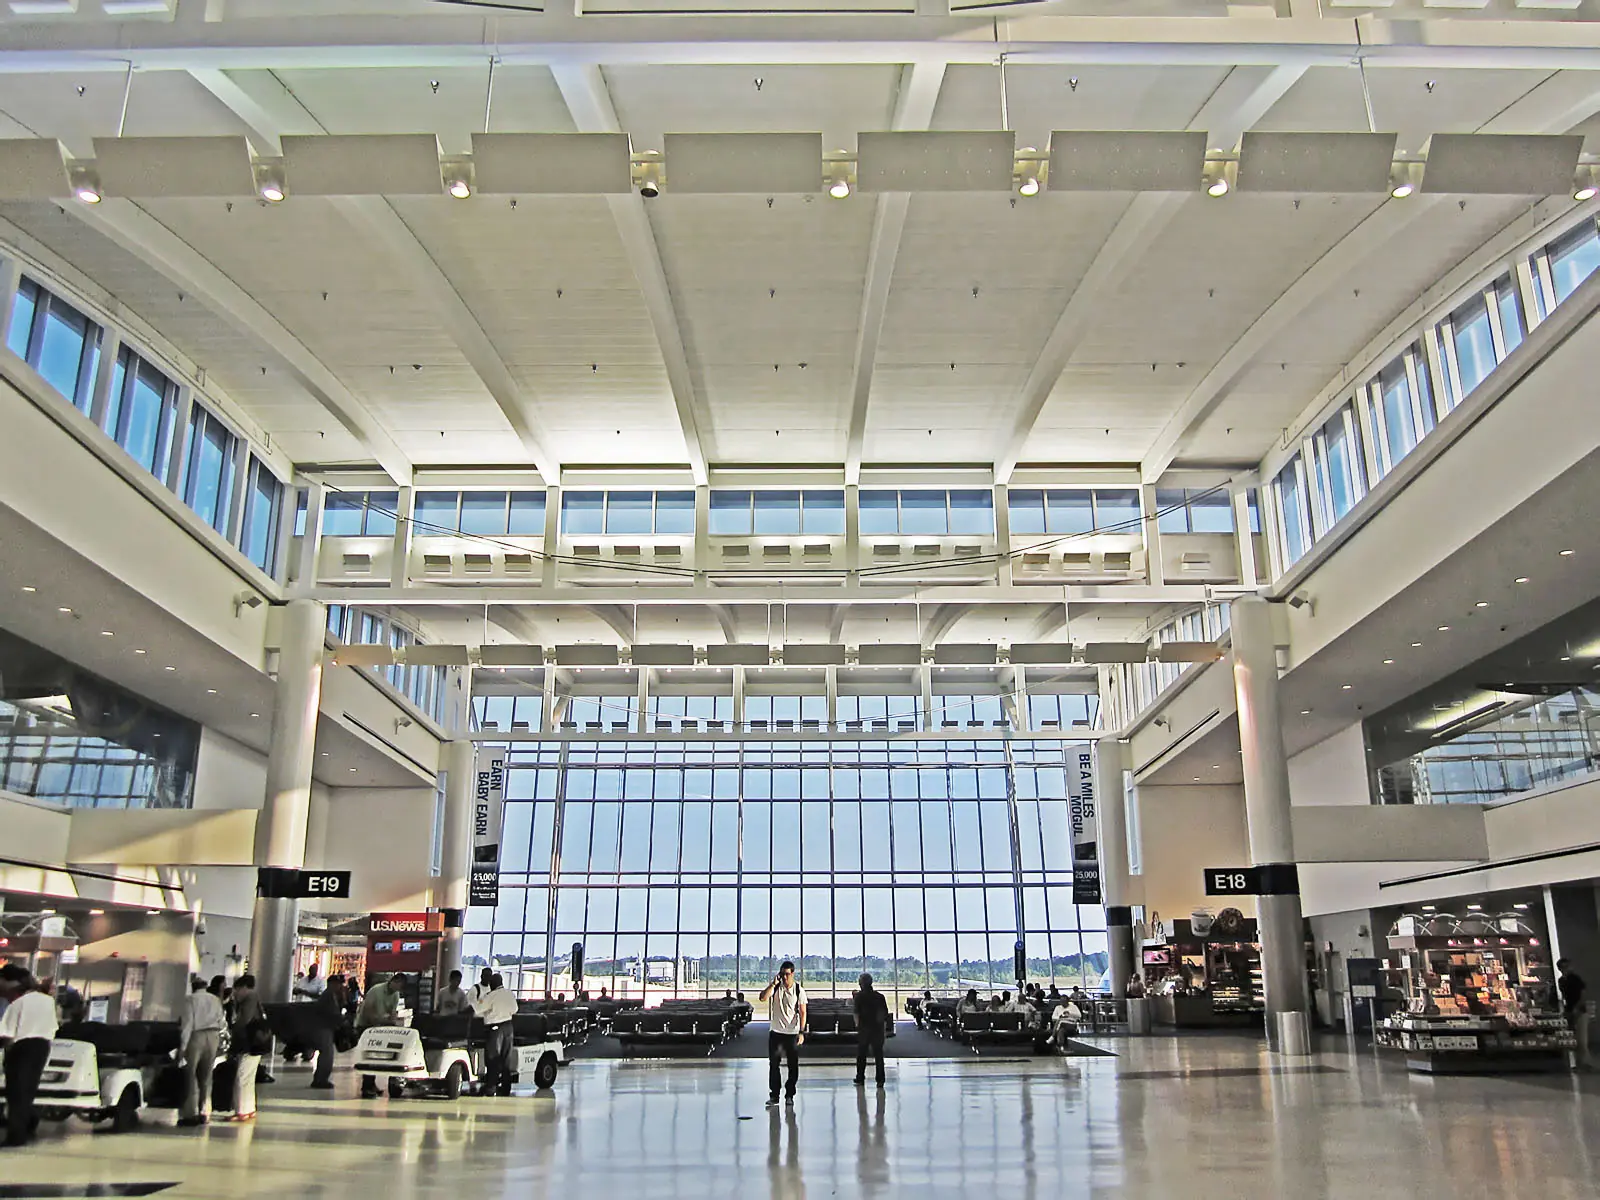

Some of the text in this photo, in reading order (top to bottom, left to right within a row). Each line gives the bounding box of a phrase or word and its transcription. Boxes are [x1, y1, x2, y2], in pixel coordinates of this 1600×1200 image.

[490, 759, 503, 791] EARN
[1079, 753, 1094, 818] BE A MILES
[475, 771, 490, 836] BABY EARN
[1070, 795, 1084, 837] MOGUL
[308, 876, 340, 892] E19
[1075, 870, 1097, 879] 25,000
[1214, 874, 1246, 889] E18
